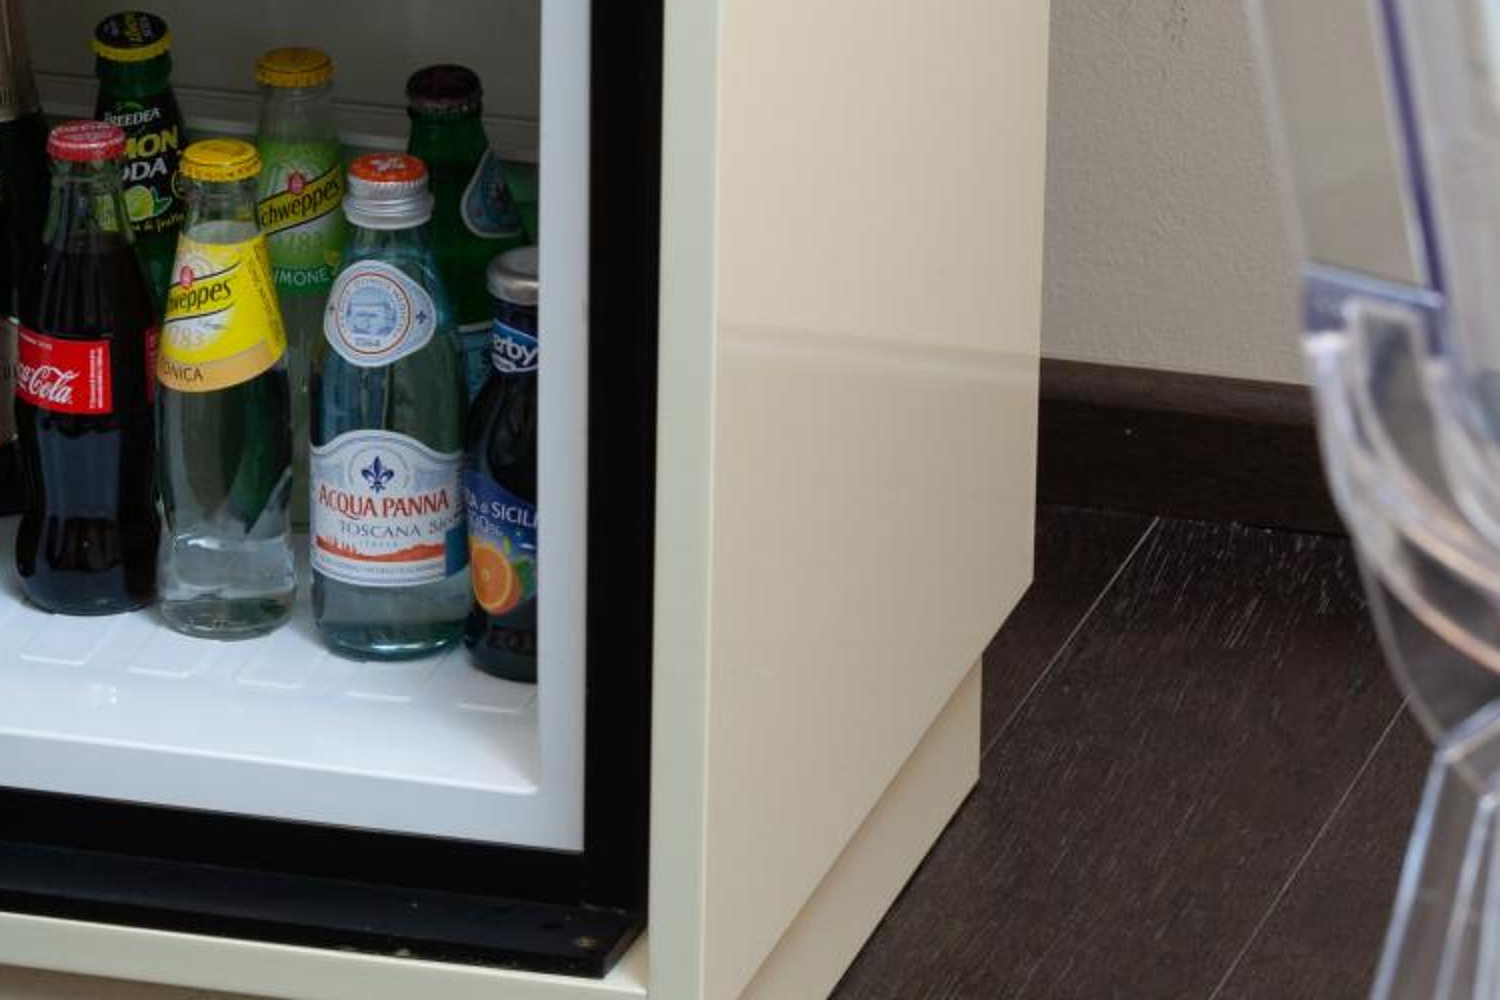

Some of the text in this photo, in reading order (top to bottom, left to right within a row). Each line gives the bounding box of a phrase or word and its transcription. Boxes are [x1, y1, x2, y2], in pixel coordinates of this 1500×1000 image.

[121, 157, 169, 182] DA
[261, 180, 339, 226] chweppes
[274, 266, 329, 287] IMONE
[163, 360, 205, 383] ONICA
[318, 480, 378, 521] ACQUA
[382, 487, 451, 519] PANNA
[339, 518, 422, 538] TOSCANA
